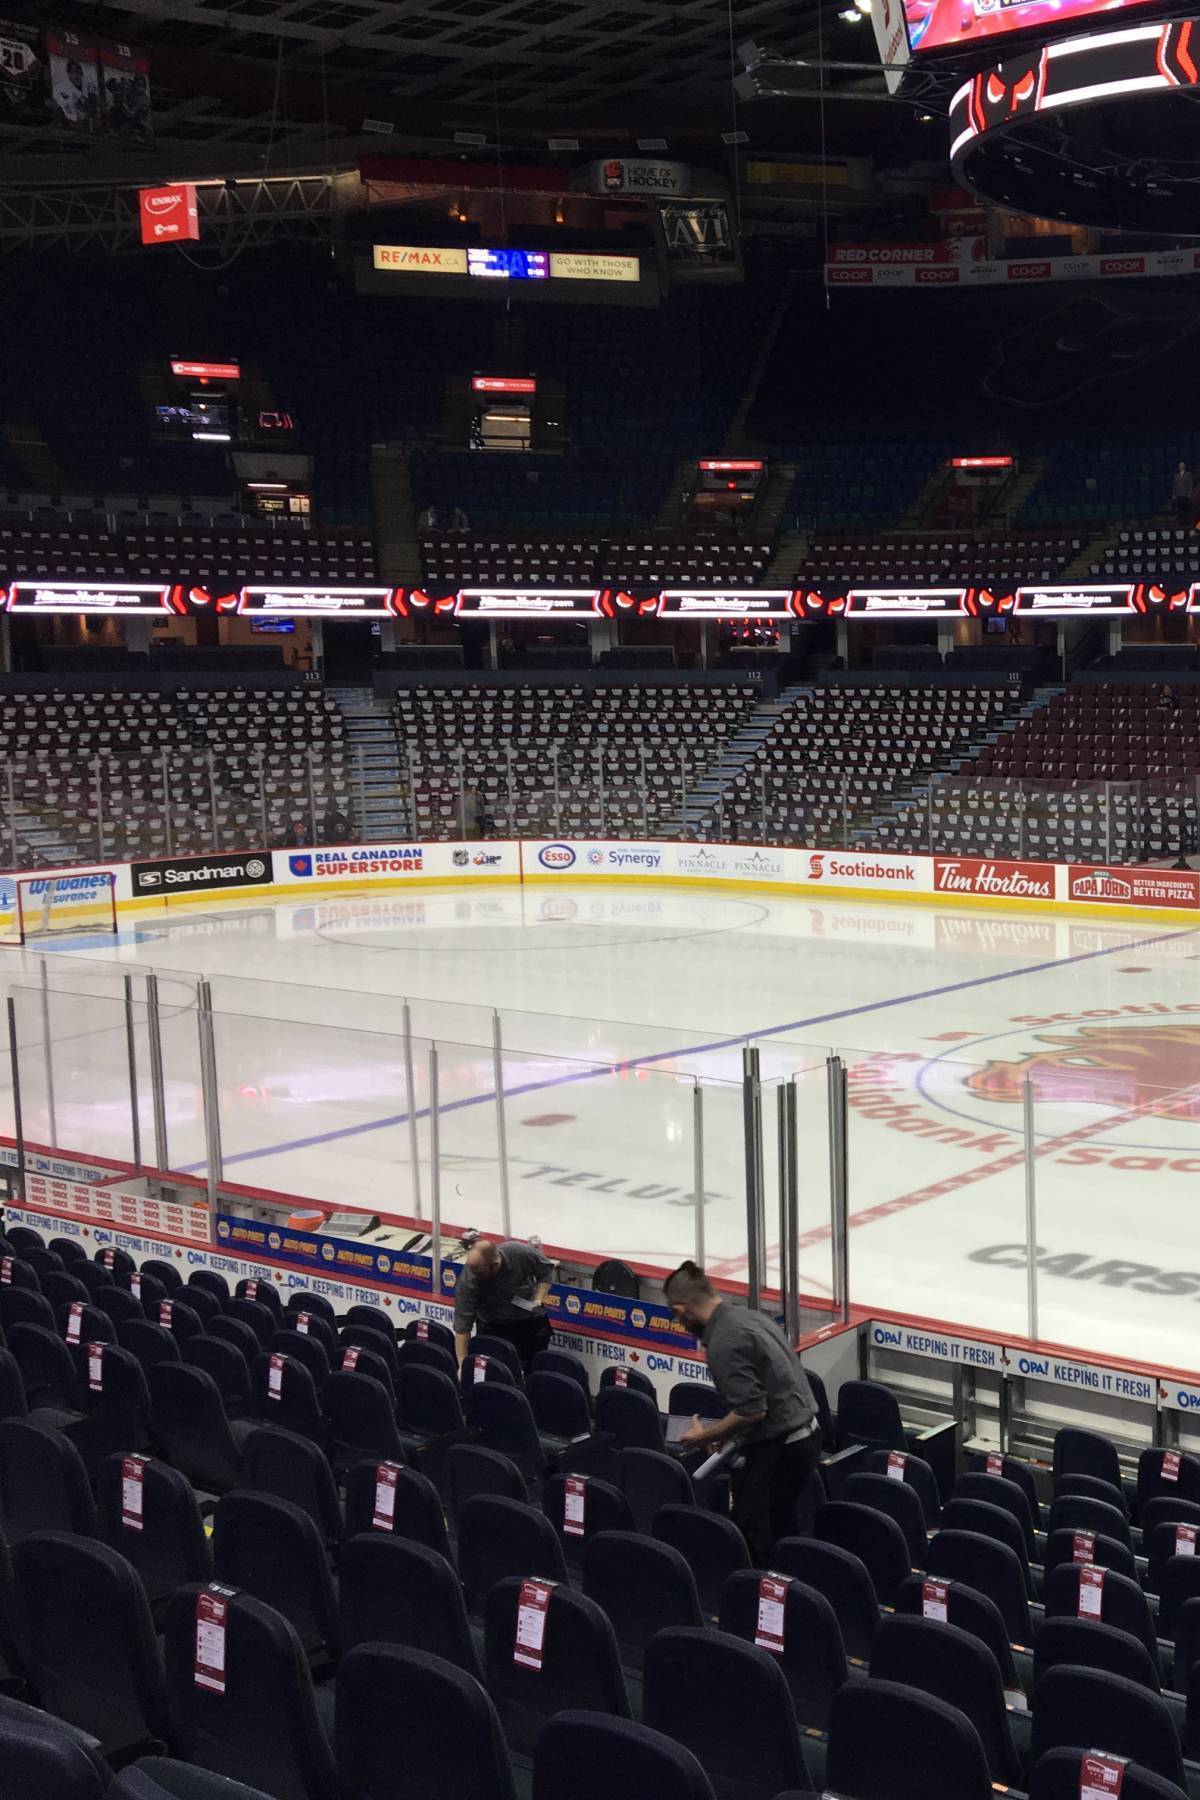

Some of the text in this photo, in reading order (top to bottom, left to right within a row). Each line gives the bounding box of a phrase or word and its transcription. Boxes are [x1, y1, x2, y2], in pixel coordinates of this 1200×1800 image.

[64, 31, 80, 46] 15
[2, 48, 25, 71] 20
[628, 167, 673, 179] HOME OF
[628, 177, 678, 191] HOCKEY
[668, 217, 729, 248] AVI
[835, 248, 936, 262] RED CORNER
[556, 258, 572, 267] GO
[575, 258, 600, 268] WITH
[602, 260, 634, 270] THOSE
[566, 266, 624, 277] WHO KNOW
[1011, 263, 1047, 278] CO-OP
[1104, 260, 1141, 273] CO-OP
[831, 270, 868, 282] CO-OP
[919, 269, 956, 281] CO-OP
[305, 672, 320, 681] 113
[748, 671, 762, 680] 112
[1008, 672, 1020, 681] 111
[315, 848, 422, 864] REAL CANADIAN
[544, 850, 572, 863] Esso
[608, 851, 662, 869] Synergy
[316, 858, 423, 877] SUPERSTORE
[678, 859, 728, 871] PINNACLE
[734, 862, 783, 874] PINNACLE
[829, 860, 915, 881] Scotiabank
[164, 862, 245, 886] Sandman
[937, 862, 1051, 897] Tim Hortons
[1074, 877, 1131, 899] PAPA JOHNS
[1133, 878, 1156, 887] BETTER
[1133, 887, 1197, 901] BETTER PIZZA.
[519, 1165, 725, 1207] TELUS
[26, 1213, 53, 1230] KEEPING
[53, 1220, 59, 1232] IT
[60, 1222, 81, 1239] FRESH
[93, 1229, 172, 1260] OPA! KEEPING IT FRESH
[186, 1250, 272, 1283] OPA! KEEPING IT FRESH
[287, 1274, 380, 1306] OPA! KEEPING IT FRESH
[399, 1298, 422, 1314] OPA!
[583, 1300, 627, 1321] AUTO PARTS
[648, 1315, 671, 1330] AUTO
[585, 1340, 626, 1363] IT FRESH
[873, 1328, 996, 1367] OPA! KEEPING IT FRESH
[646, 1353, 674, 1372] OPA!
[1018, 1358, 1151, 1400] OPA! KEEPING IT FRESH
